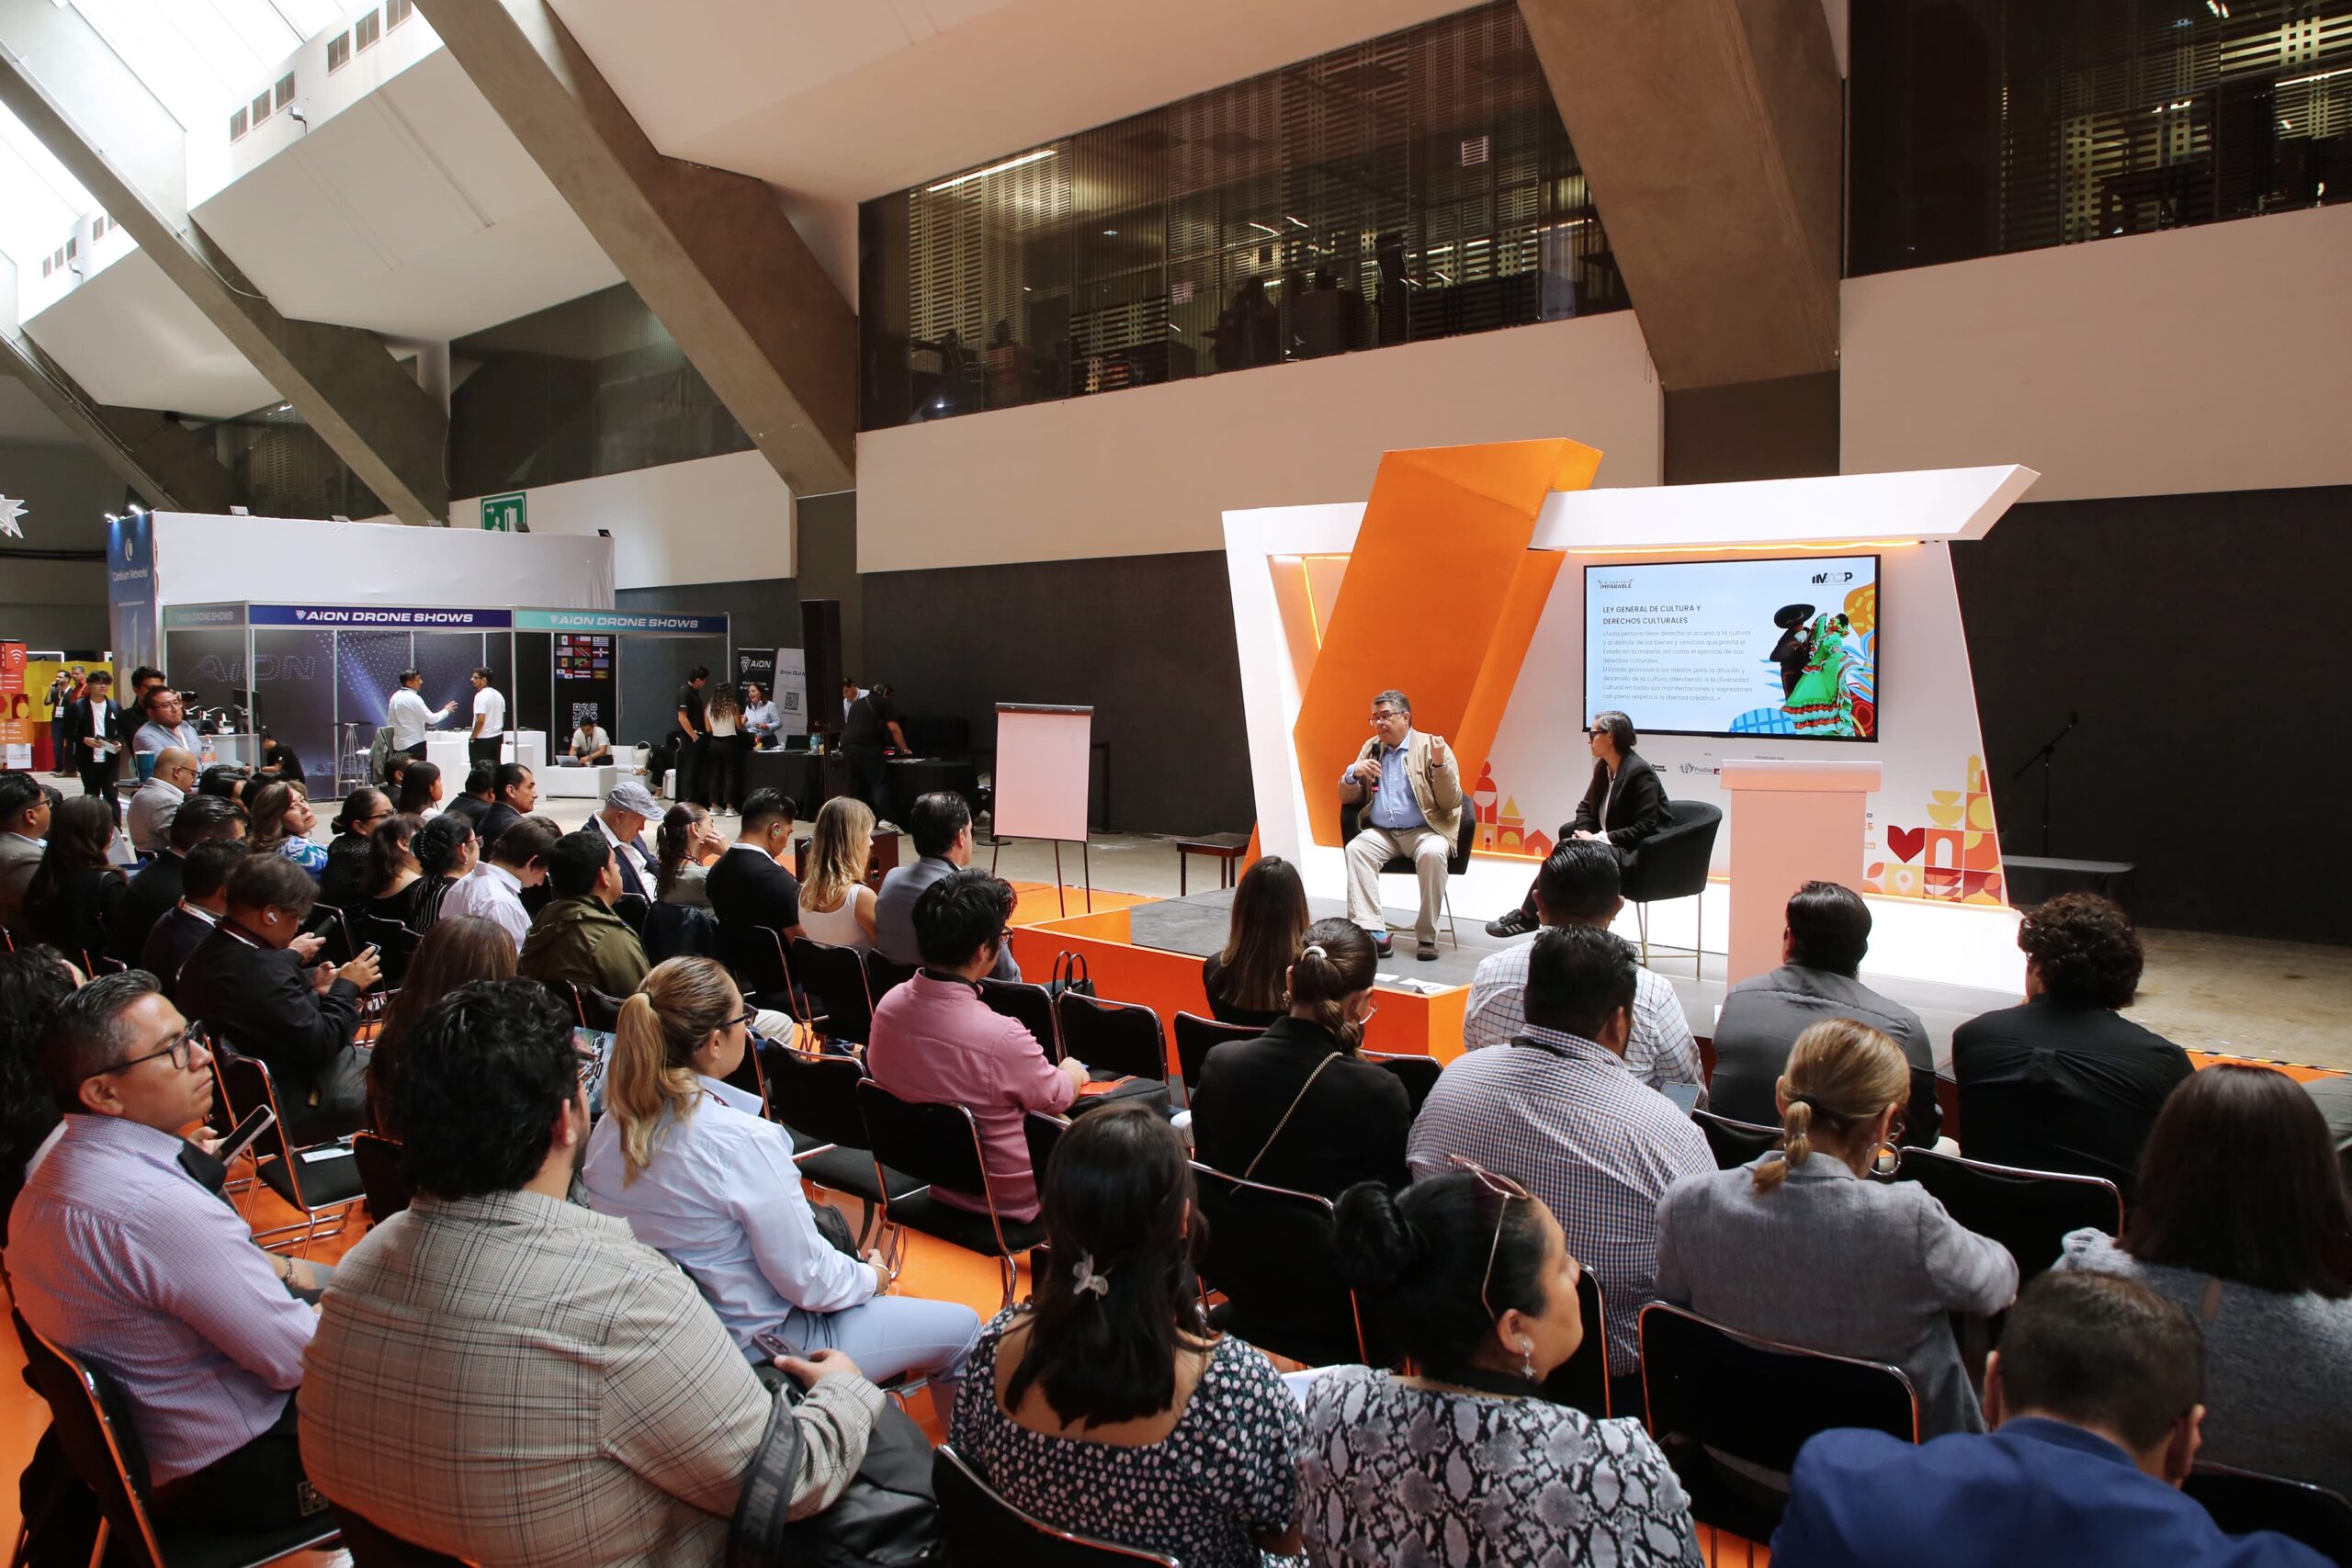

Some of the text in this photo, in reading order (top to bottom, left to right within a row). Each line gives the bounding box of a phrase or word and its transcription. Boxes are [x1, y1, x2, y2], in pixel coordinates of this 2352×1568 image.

[1616, 605, 1648, 614] GENERAL
[1660, 604, 1694, 613] CULTURA
[352, 612, 412, 622] DRONE
[413, 613, 474, 623] SHOWS
[597, 617, 646, 626] DRONE
[648, 618, 699, 628] SHOWS
[1602, 616, 1689, 626] DERECHOS CULTURALES
